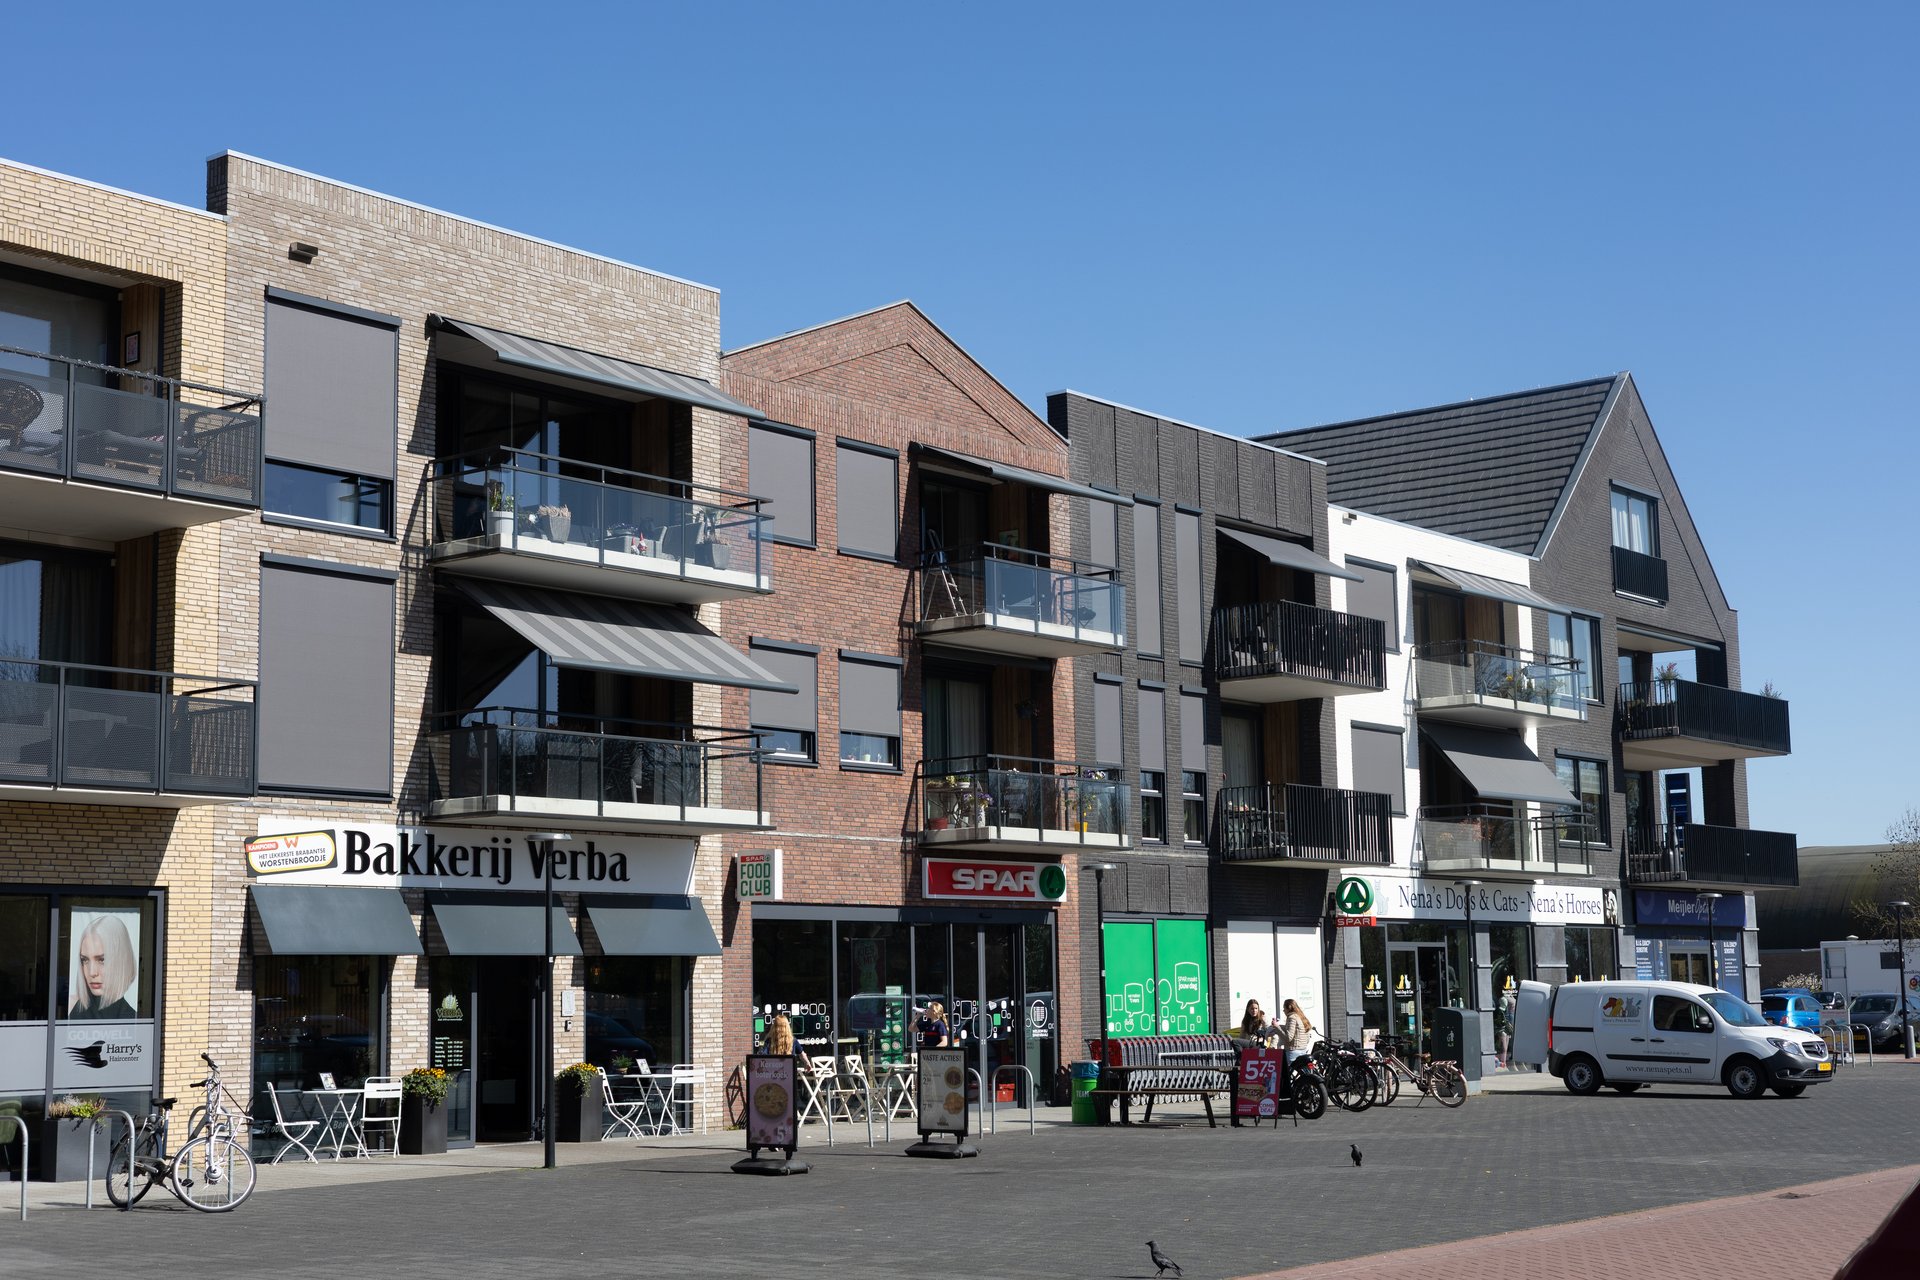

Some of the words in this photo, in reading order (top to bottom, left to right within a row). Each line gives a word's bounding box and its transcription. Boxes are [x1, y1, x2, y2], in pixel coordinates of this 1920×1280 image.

[268, 850, 295, 858] LEKKERSTE
[295, 847, 326, 856] BRABANTSE
[342, 829, 513, 885] Bakkerij
[524, 837, 631, 882] Verba
[259, 854, 327, 867] WORSTENBROODJE
[741, 863, 771, 879] FOOD
[951, 868, 1036, 892] SPAR
[741, 880, 771, 897] CLUB
[1399, 885, 1442, 909] Nena's
[1445, 887, 1476, 917] Dogs
[1479, 889, 1490, 911] &
[1493, 889, 1519, 912] Cats
[1527, 891, 1564, 914] Nena's
[1565, 893, 1601, 914] Horses
[1337, 918, 1371, 926] SPAR
[68, 1029, 133, 1041] GOLDWELL
[106, 1044, 142, 1055] Harry's
[940, 1054, 962, 1062] ACTIES!
[1245, 1060, 1276, 1080] 5.75
[1625, 1065, 1693, 1075] www.nenaspets.nl
